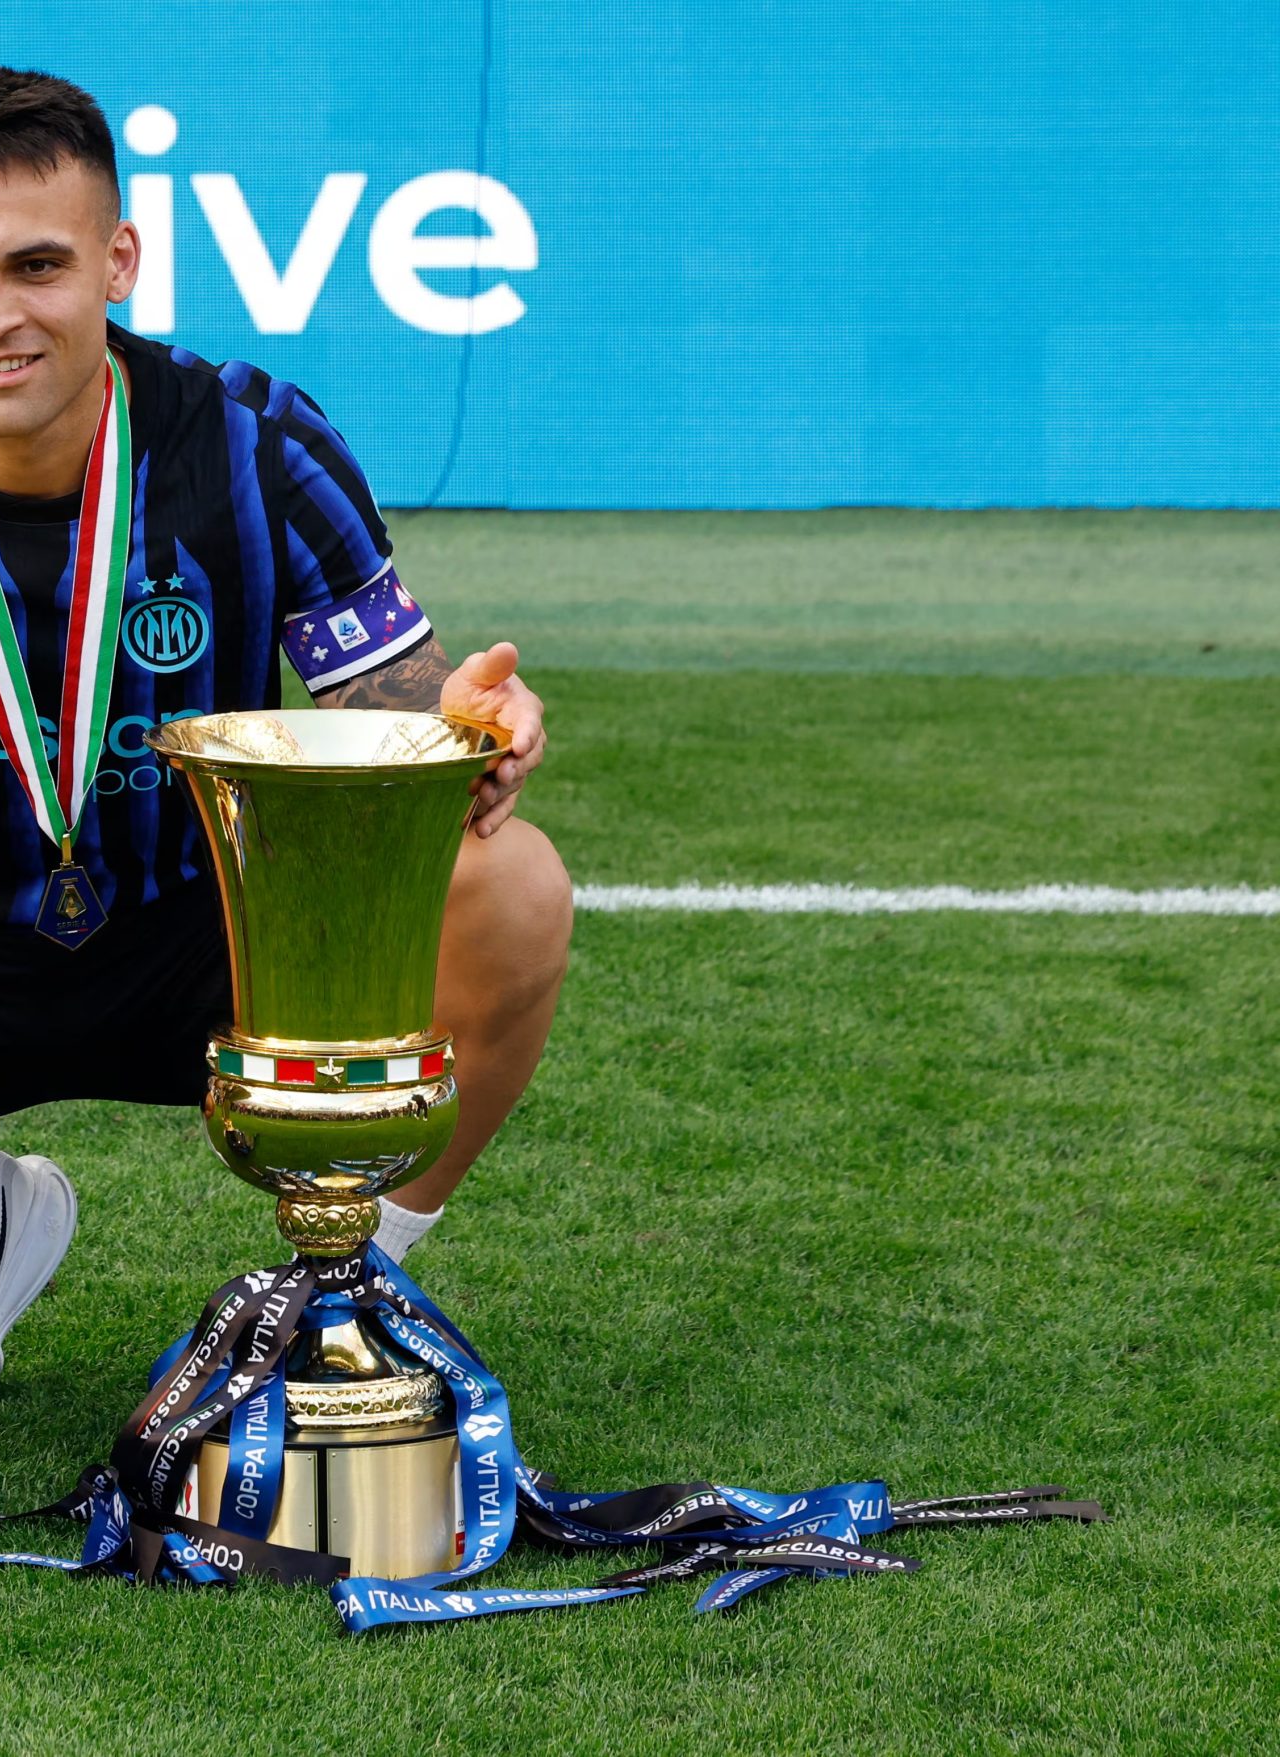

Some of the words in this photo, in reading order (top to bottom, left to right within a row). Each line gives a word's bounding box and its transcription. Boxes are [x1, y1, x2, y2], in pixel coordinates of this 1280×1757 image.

[247, 1293, 290, 1363] ITALIA
[138, 1294, 246, 1440] FRECCIAROSSA
[246, 1392, 269, 1441] ITALIA
[235, 1447, 266, 1520] COPPA
[477, 1450, 501, 1527] ITALIA
[638, 1495, 728, 1536] FRECCIA
[734, 1542, 905, 1569] FRECCIAROSSA
[368, 1590, 441, 1612] ITALIA
